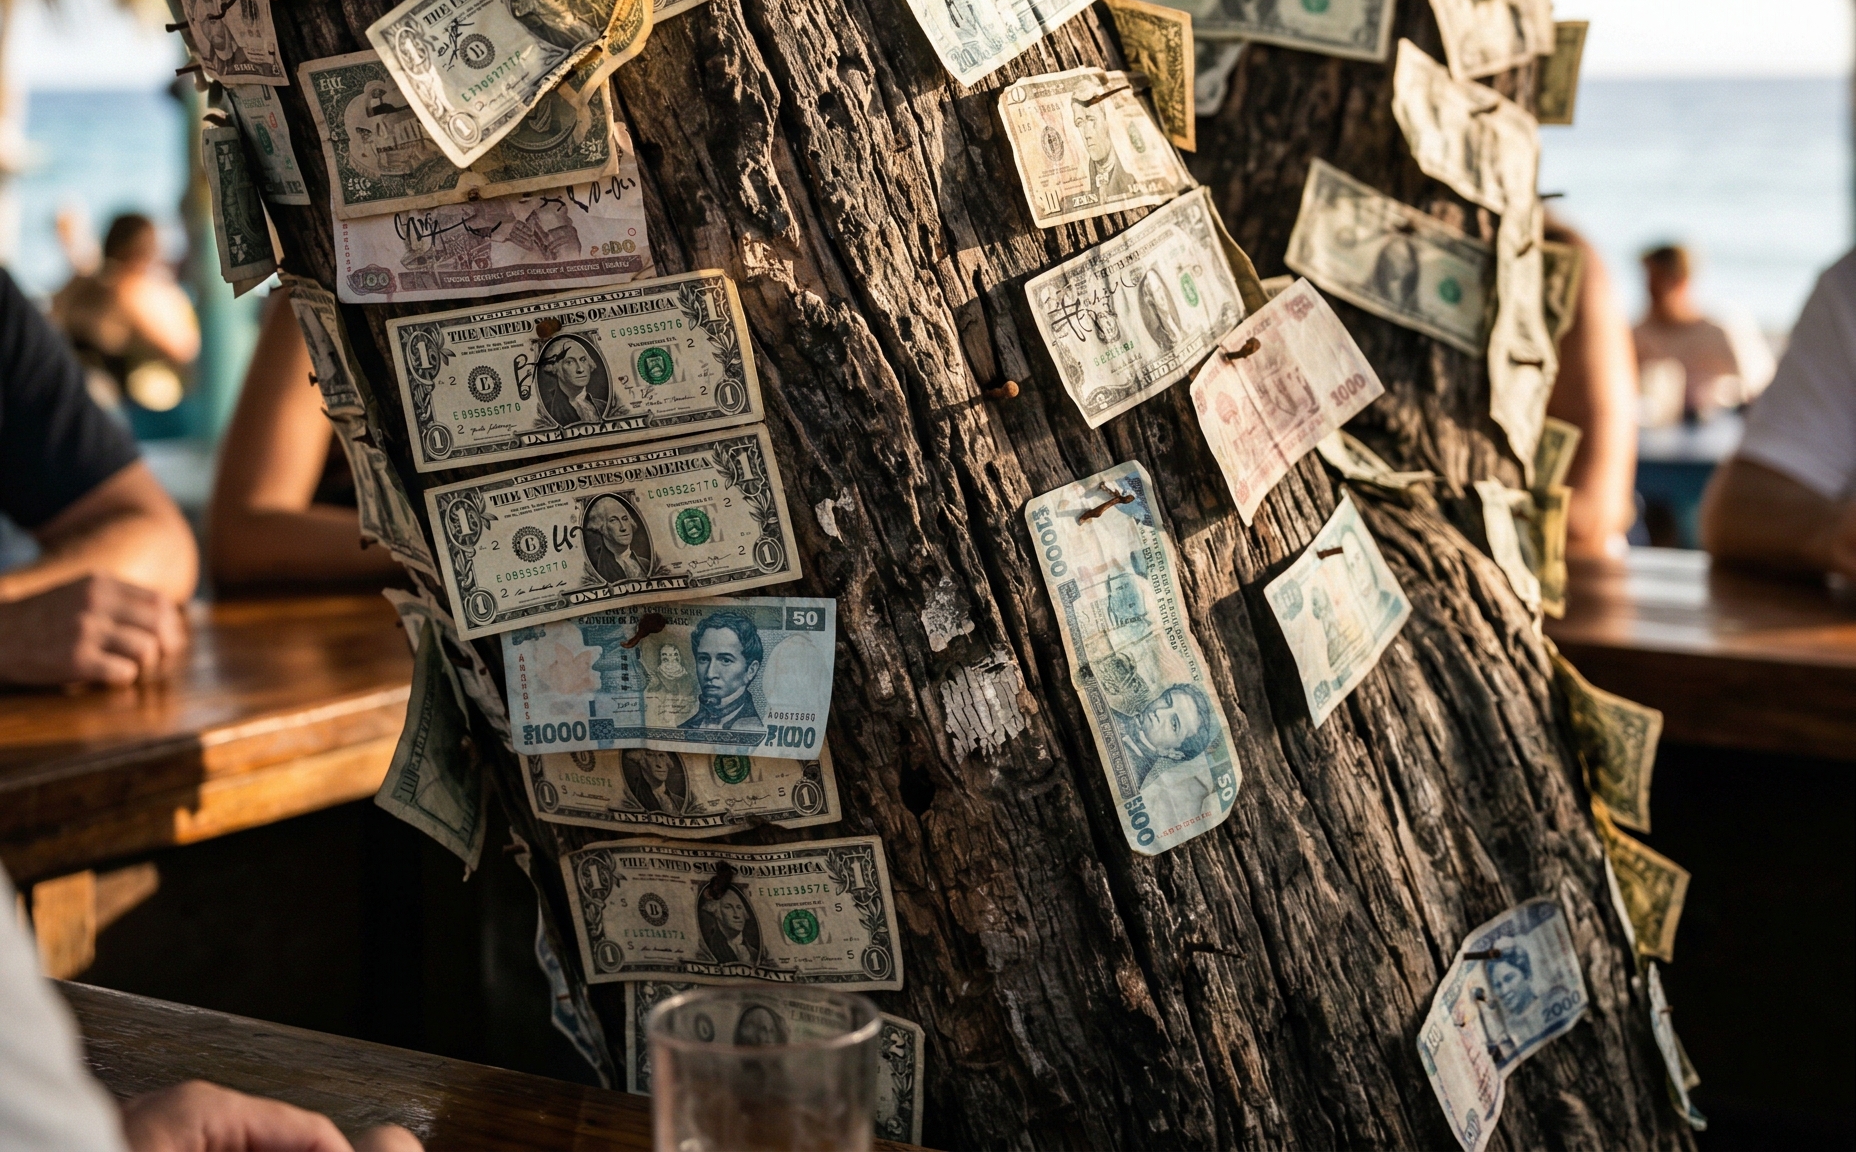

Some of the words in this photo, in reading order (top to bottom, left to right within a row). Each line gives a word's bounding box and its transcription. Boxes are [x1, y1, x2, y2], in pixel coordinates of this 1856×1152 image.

[447, 327, 480, 343] THE
[609, 297, 678, 319] AMERICA
[687, 339, 695, 348] 2
[449, 376, 457, 386] 2
[700, 385, 708, 395] 2
[1329, 373, 1367, 407] 1000
[457, 425, 465, 434] 2
[723, 497, 732, 507] 2
[491, 541, 500, 551] 2
[737, 545, 746, 555] 2
[500, 588, 509, 598] 2
[570, 588, 610, 604] ONE
[792, 610, 819, 627] 50
[619, 857, 647, 868] THE
